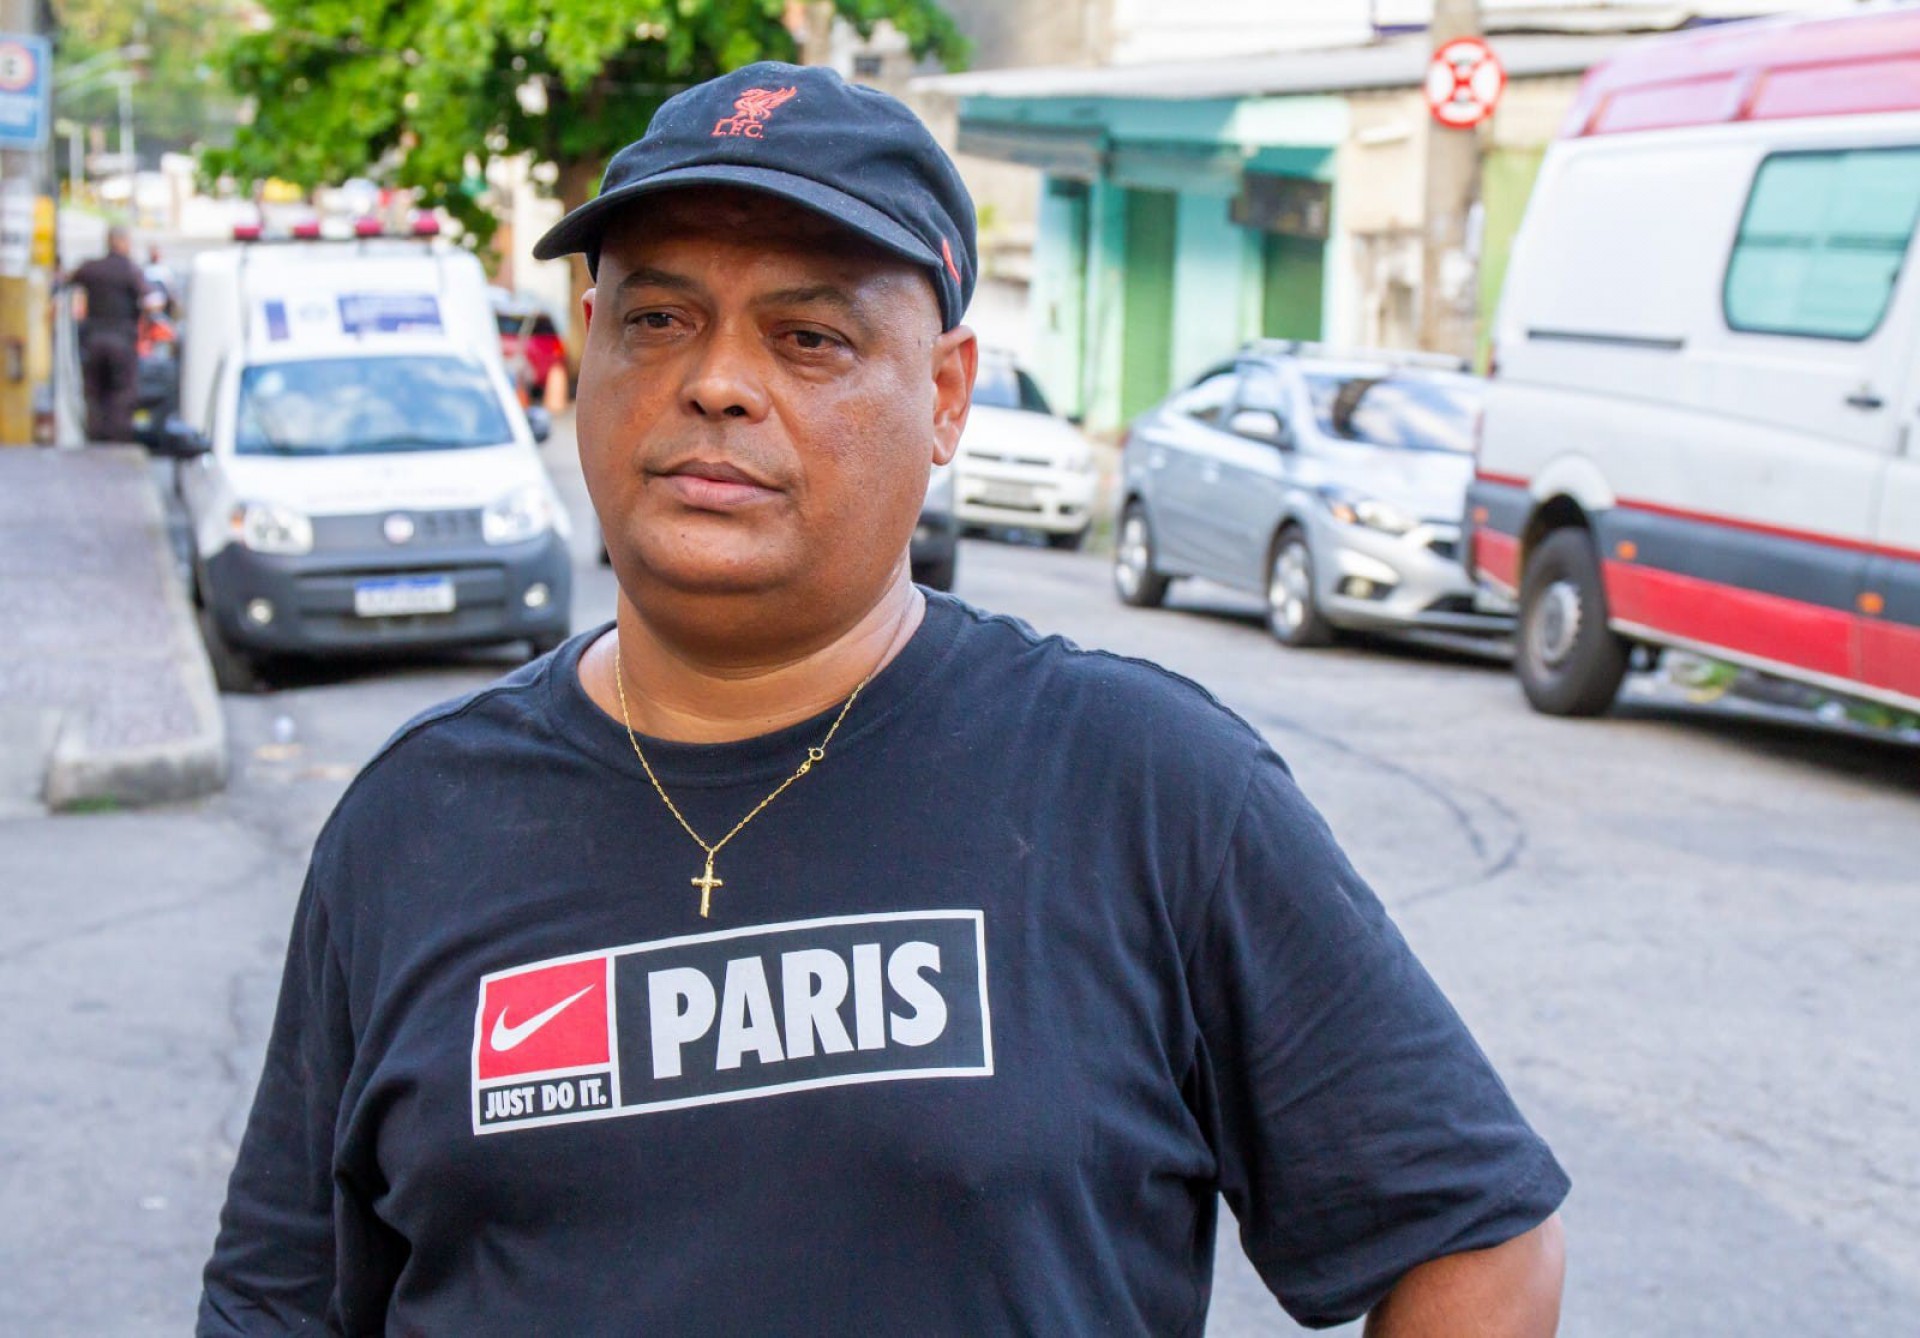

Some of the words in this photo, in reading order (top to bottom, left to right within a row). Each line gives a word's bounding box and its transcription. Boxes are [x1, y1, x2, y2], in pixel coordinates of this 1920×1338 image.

[647, 940, 948, 1080] PARIS
[485, 1086, 535, 1120] JUST
[541, 1081, 575, 1111] DO
[579, 1078, 607, 1107] IT.
